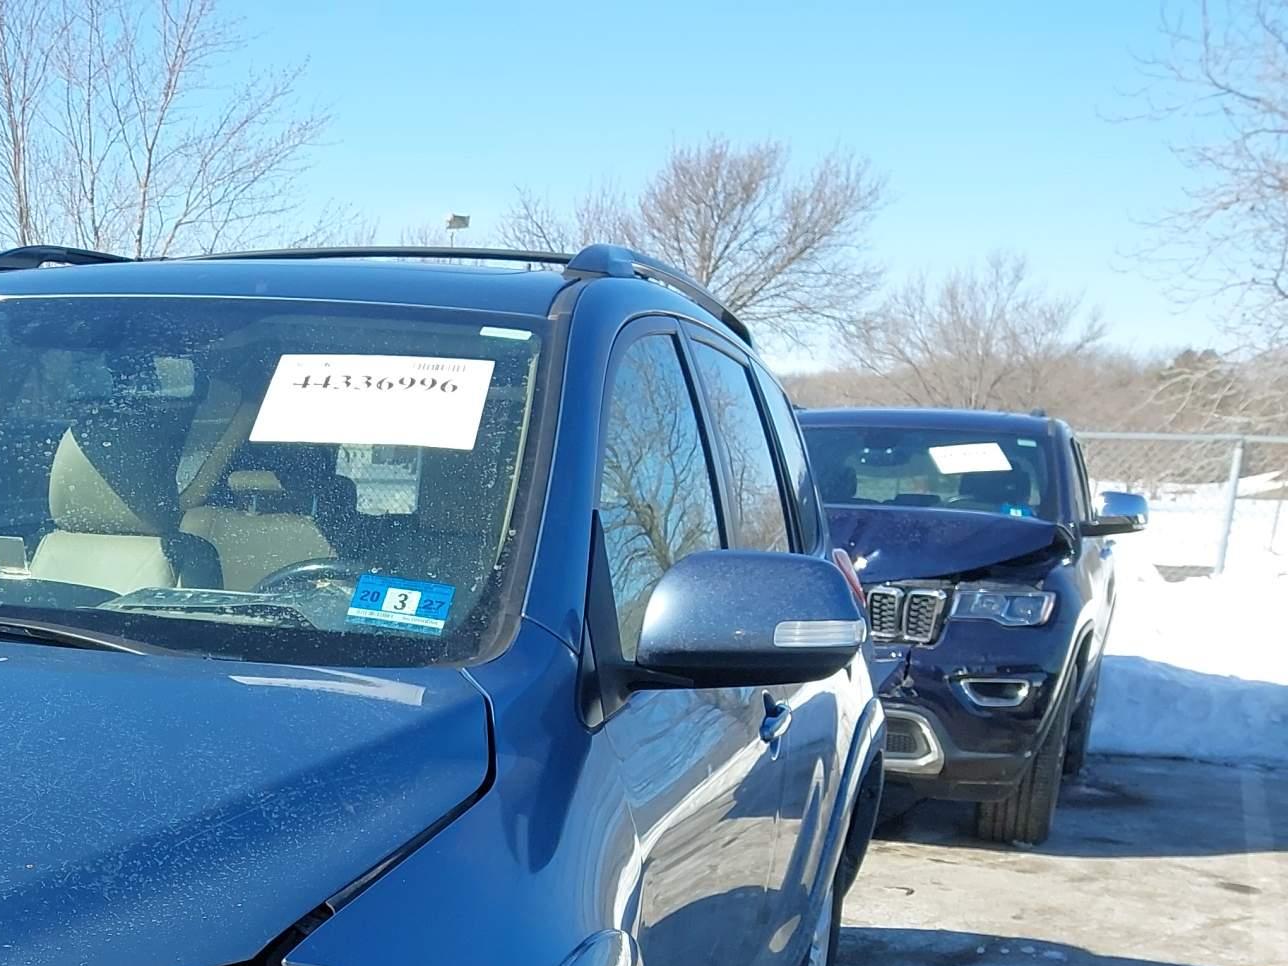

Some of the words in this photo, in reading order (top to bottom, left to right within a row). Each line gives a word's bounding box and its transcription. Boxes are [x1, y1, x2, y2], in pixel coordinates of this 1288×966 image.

[292, 375, 458, 392] 44336996
[360, 590, 381, 602] 20
[393, 593, 409, 610] 3
[422, 599, 445, 611] 27
